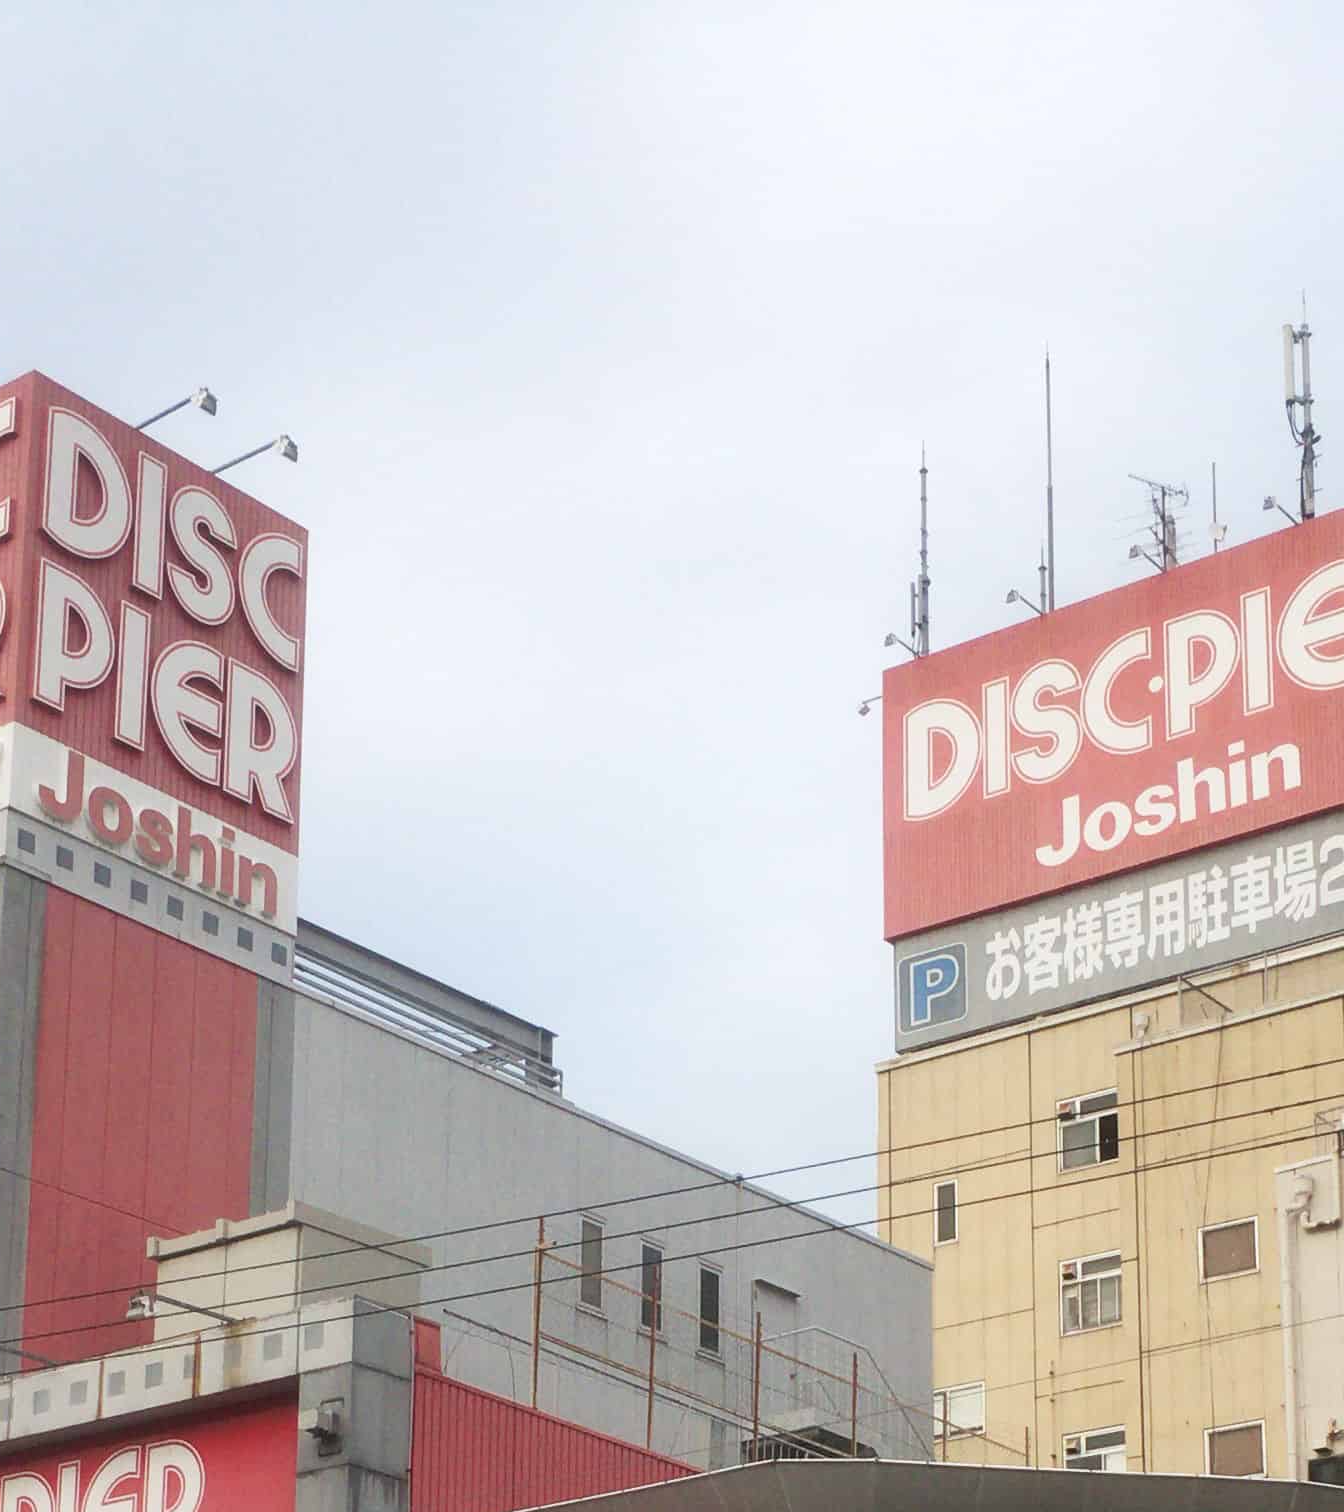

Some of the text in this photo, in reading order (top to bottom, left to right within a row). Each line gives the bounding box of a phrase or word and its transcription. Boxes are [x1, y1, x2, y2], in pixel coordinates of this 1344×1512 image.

[40, 405, 304, 673] DISC
[32, 558, 296, 825] PIER
[36, 748, 279, 919] Joshin
[1034, 739, 1303, 868] Joshin
[909, 954, 960, 1027] P
